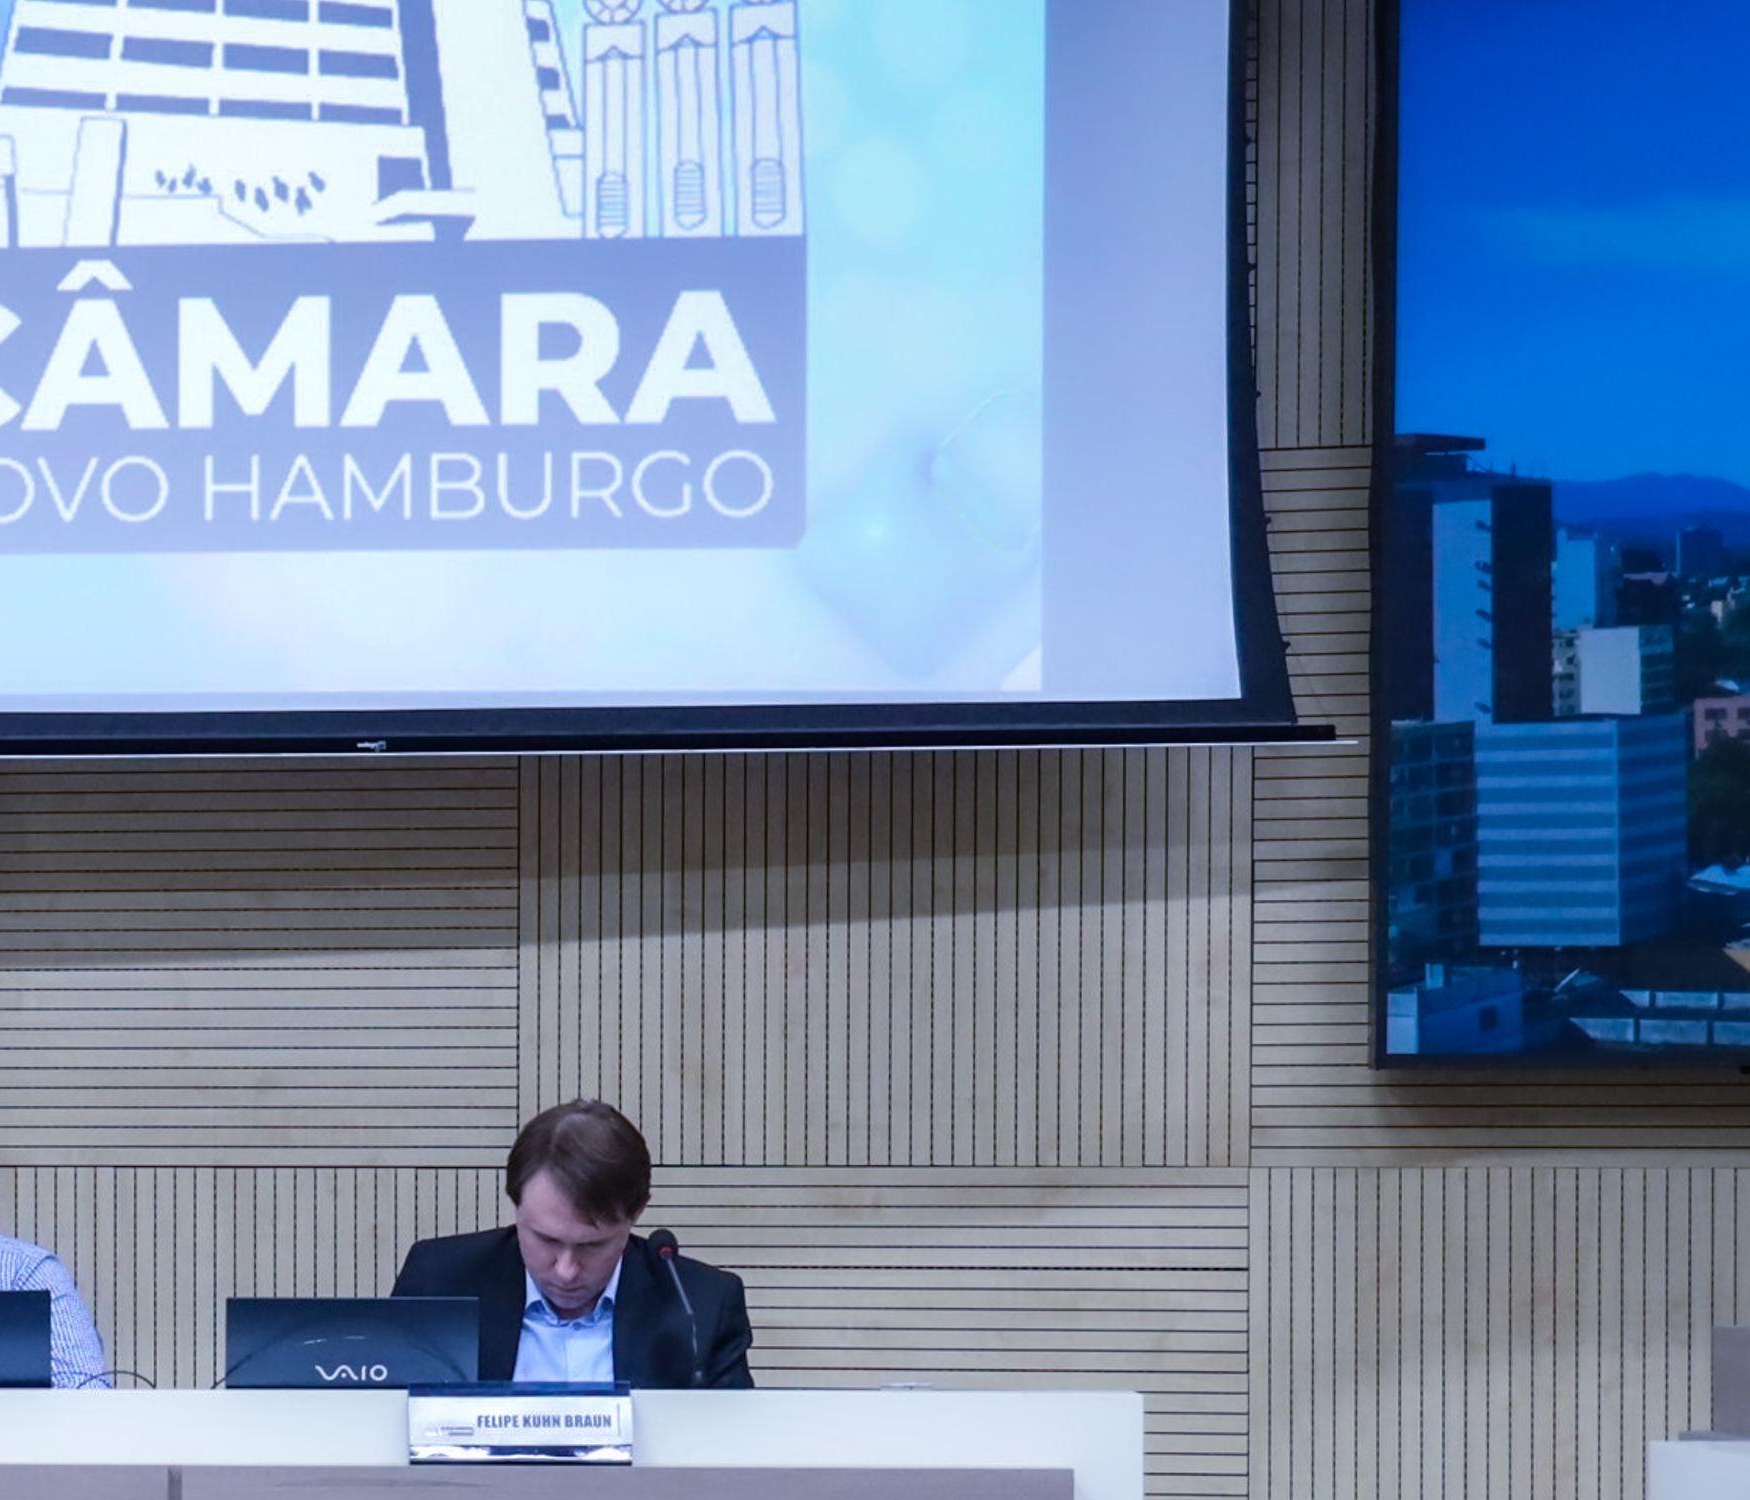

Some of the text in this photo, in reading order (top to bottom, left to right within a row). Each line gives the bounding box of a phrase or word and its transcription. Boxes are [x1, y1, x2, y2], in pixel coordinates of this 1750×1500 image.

[203, 449, 774, 522] HAMBURGO
[315, 1365, 388, 1381] VAIO
[477, 1414, 612, 1429] FELIPE KUHN BRAUN
